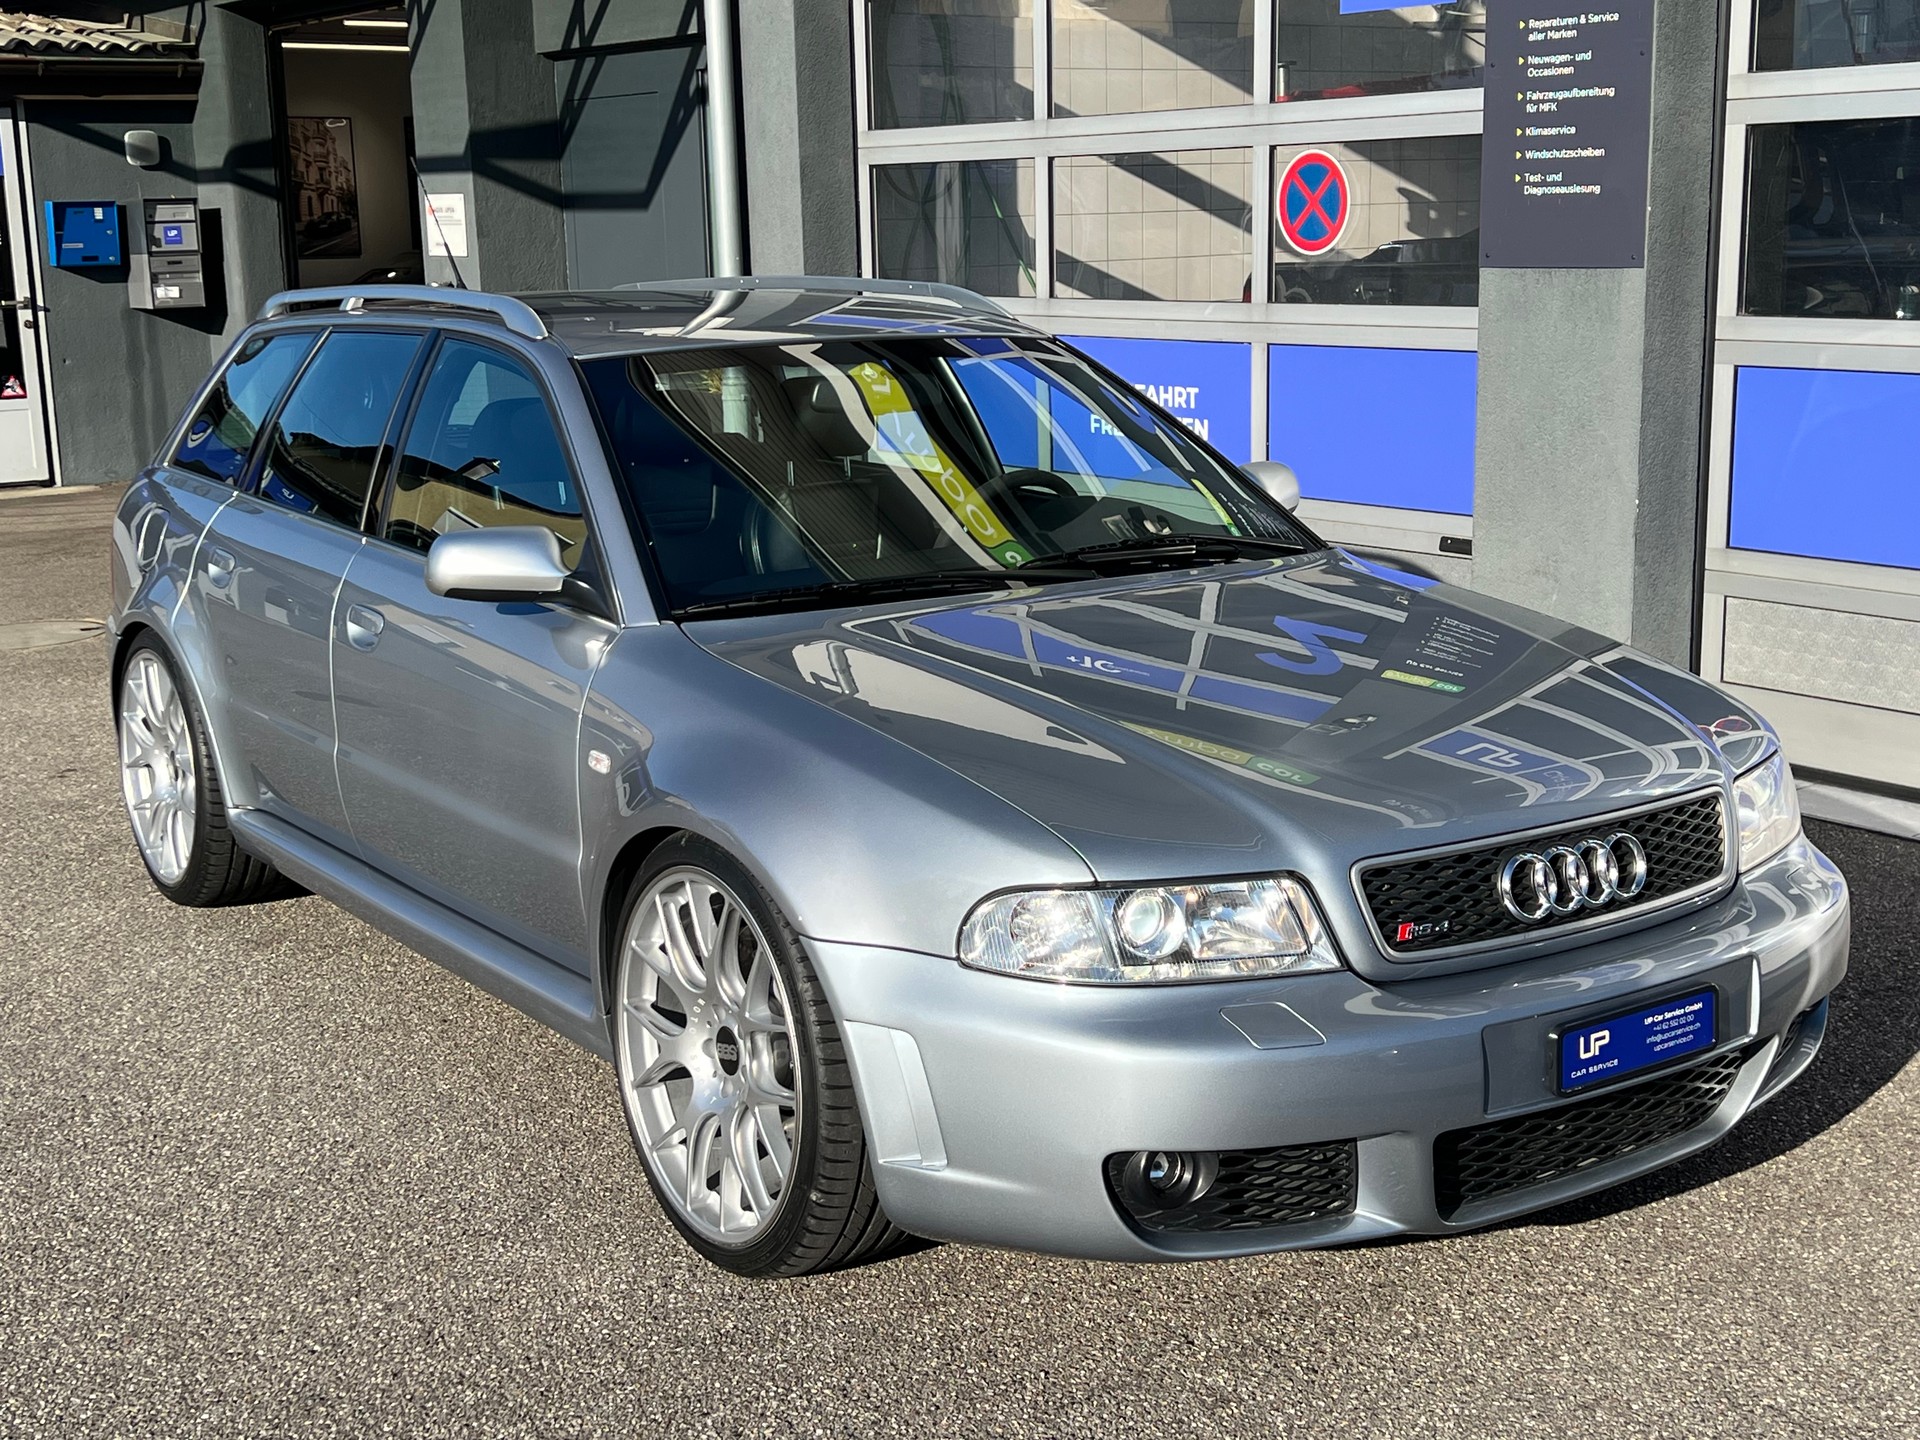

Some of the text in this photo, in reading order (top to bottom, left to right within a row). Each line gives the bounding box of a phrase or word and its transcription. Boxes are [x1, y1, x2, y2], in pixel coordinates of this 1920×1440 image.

[1529, 12, 1620, 29] Reparaturen & Service
[1528, 29, 1577, 41] aller Marken
[1528, 50, 1592, 64] Neuwagen- und
[1528, 66, 1574, 77] Occasionen
[1526, 86, 1615, 100] Fahrzeugaufbereitung
[1526, 102, 1557, 113] für MFK
[1525, 125, 1576, 136] Klimaservice
[1525, 147, 1605, 159] Windschutzscheiben
[1524, 171, 1562, 182] Test- und
[1524, 184, 1601, 196] Diagnoseauslesung
[1644, 1001, 1703, 1025] UP Car Service GmbH
[1646, 1022, 1701, 1044] info@upcarservice.ch
[1579, 1029, 1610, 1060] UP
[1653, 1034, 1694, 1052] upcarservice.ch
[717, 1042, 738, 1062] BBS
[1571, 1058, 1619, 1079] CAR SERVICE
